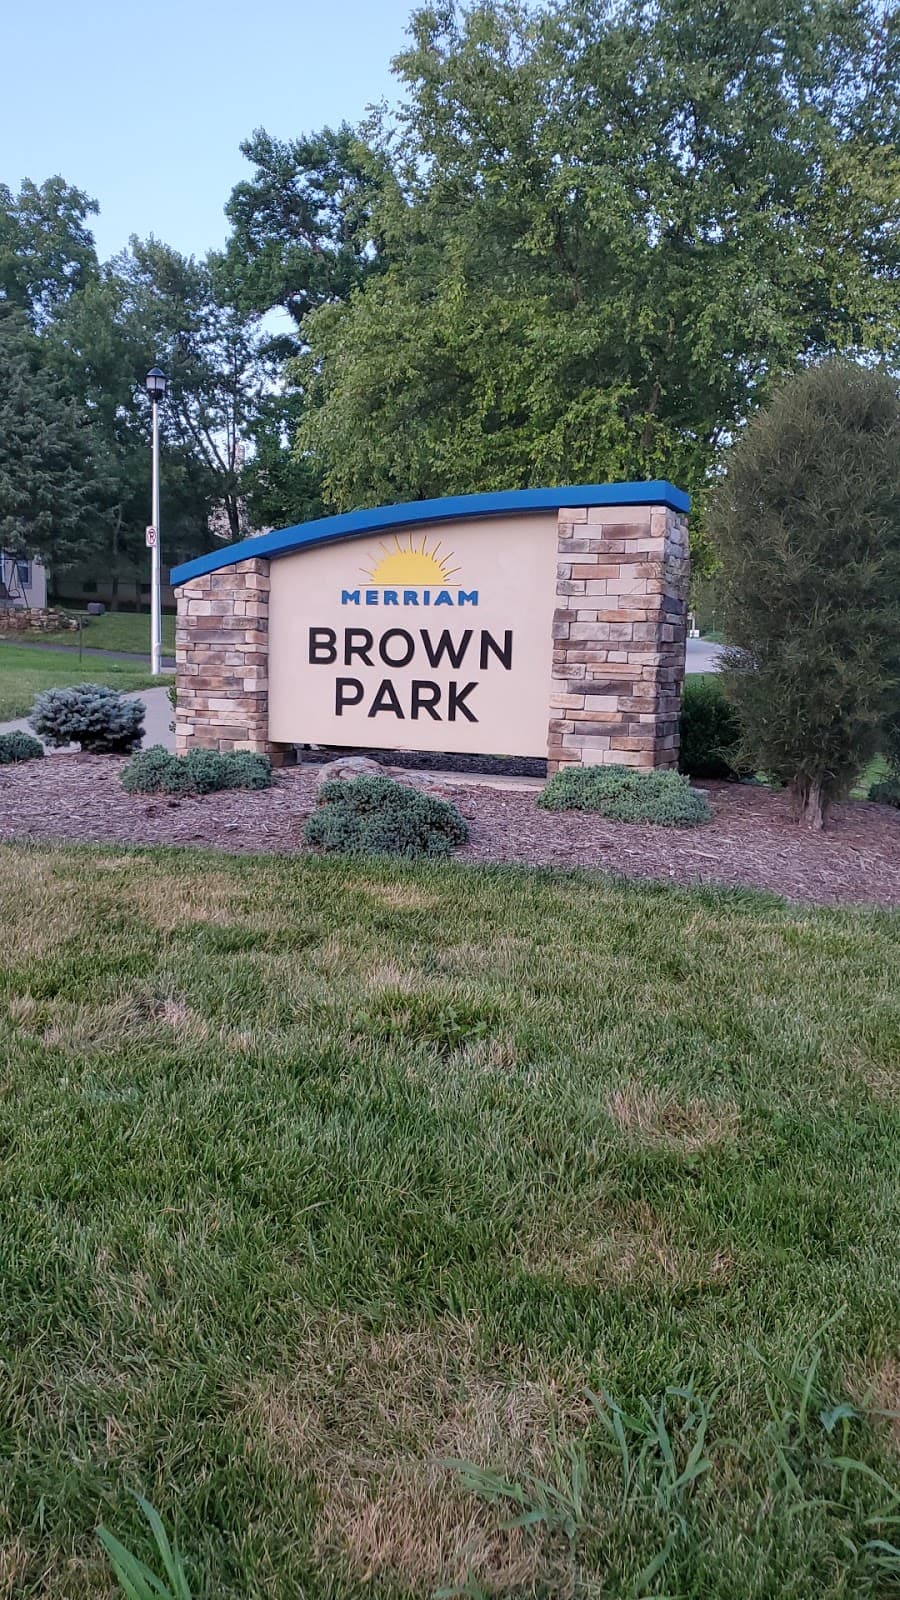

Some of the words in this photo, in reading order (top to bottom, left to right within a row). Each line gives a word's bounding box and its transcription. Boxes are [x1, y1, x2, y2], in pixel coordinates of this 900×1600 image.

[341, 590, 478, 606] MERRIAM
[308, 627, 512, 670] BROWN
[336, 678, 479, 722] PARK
